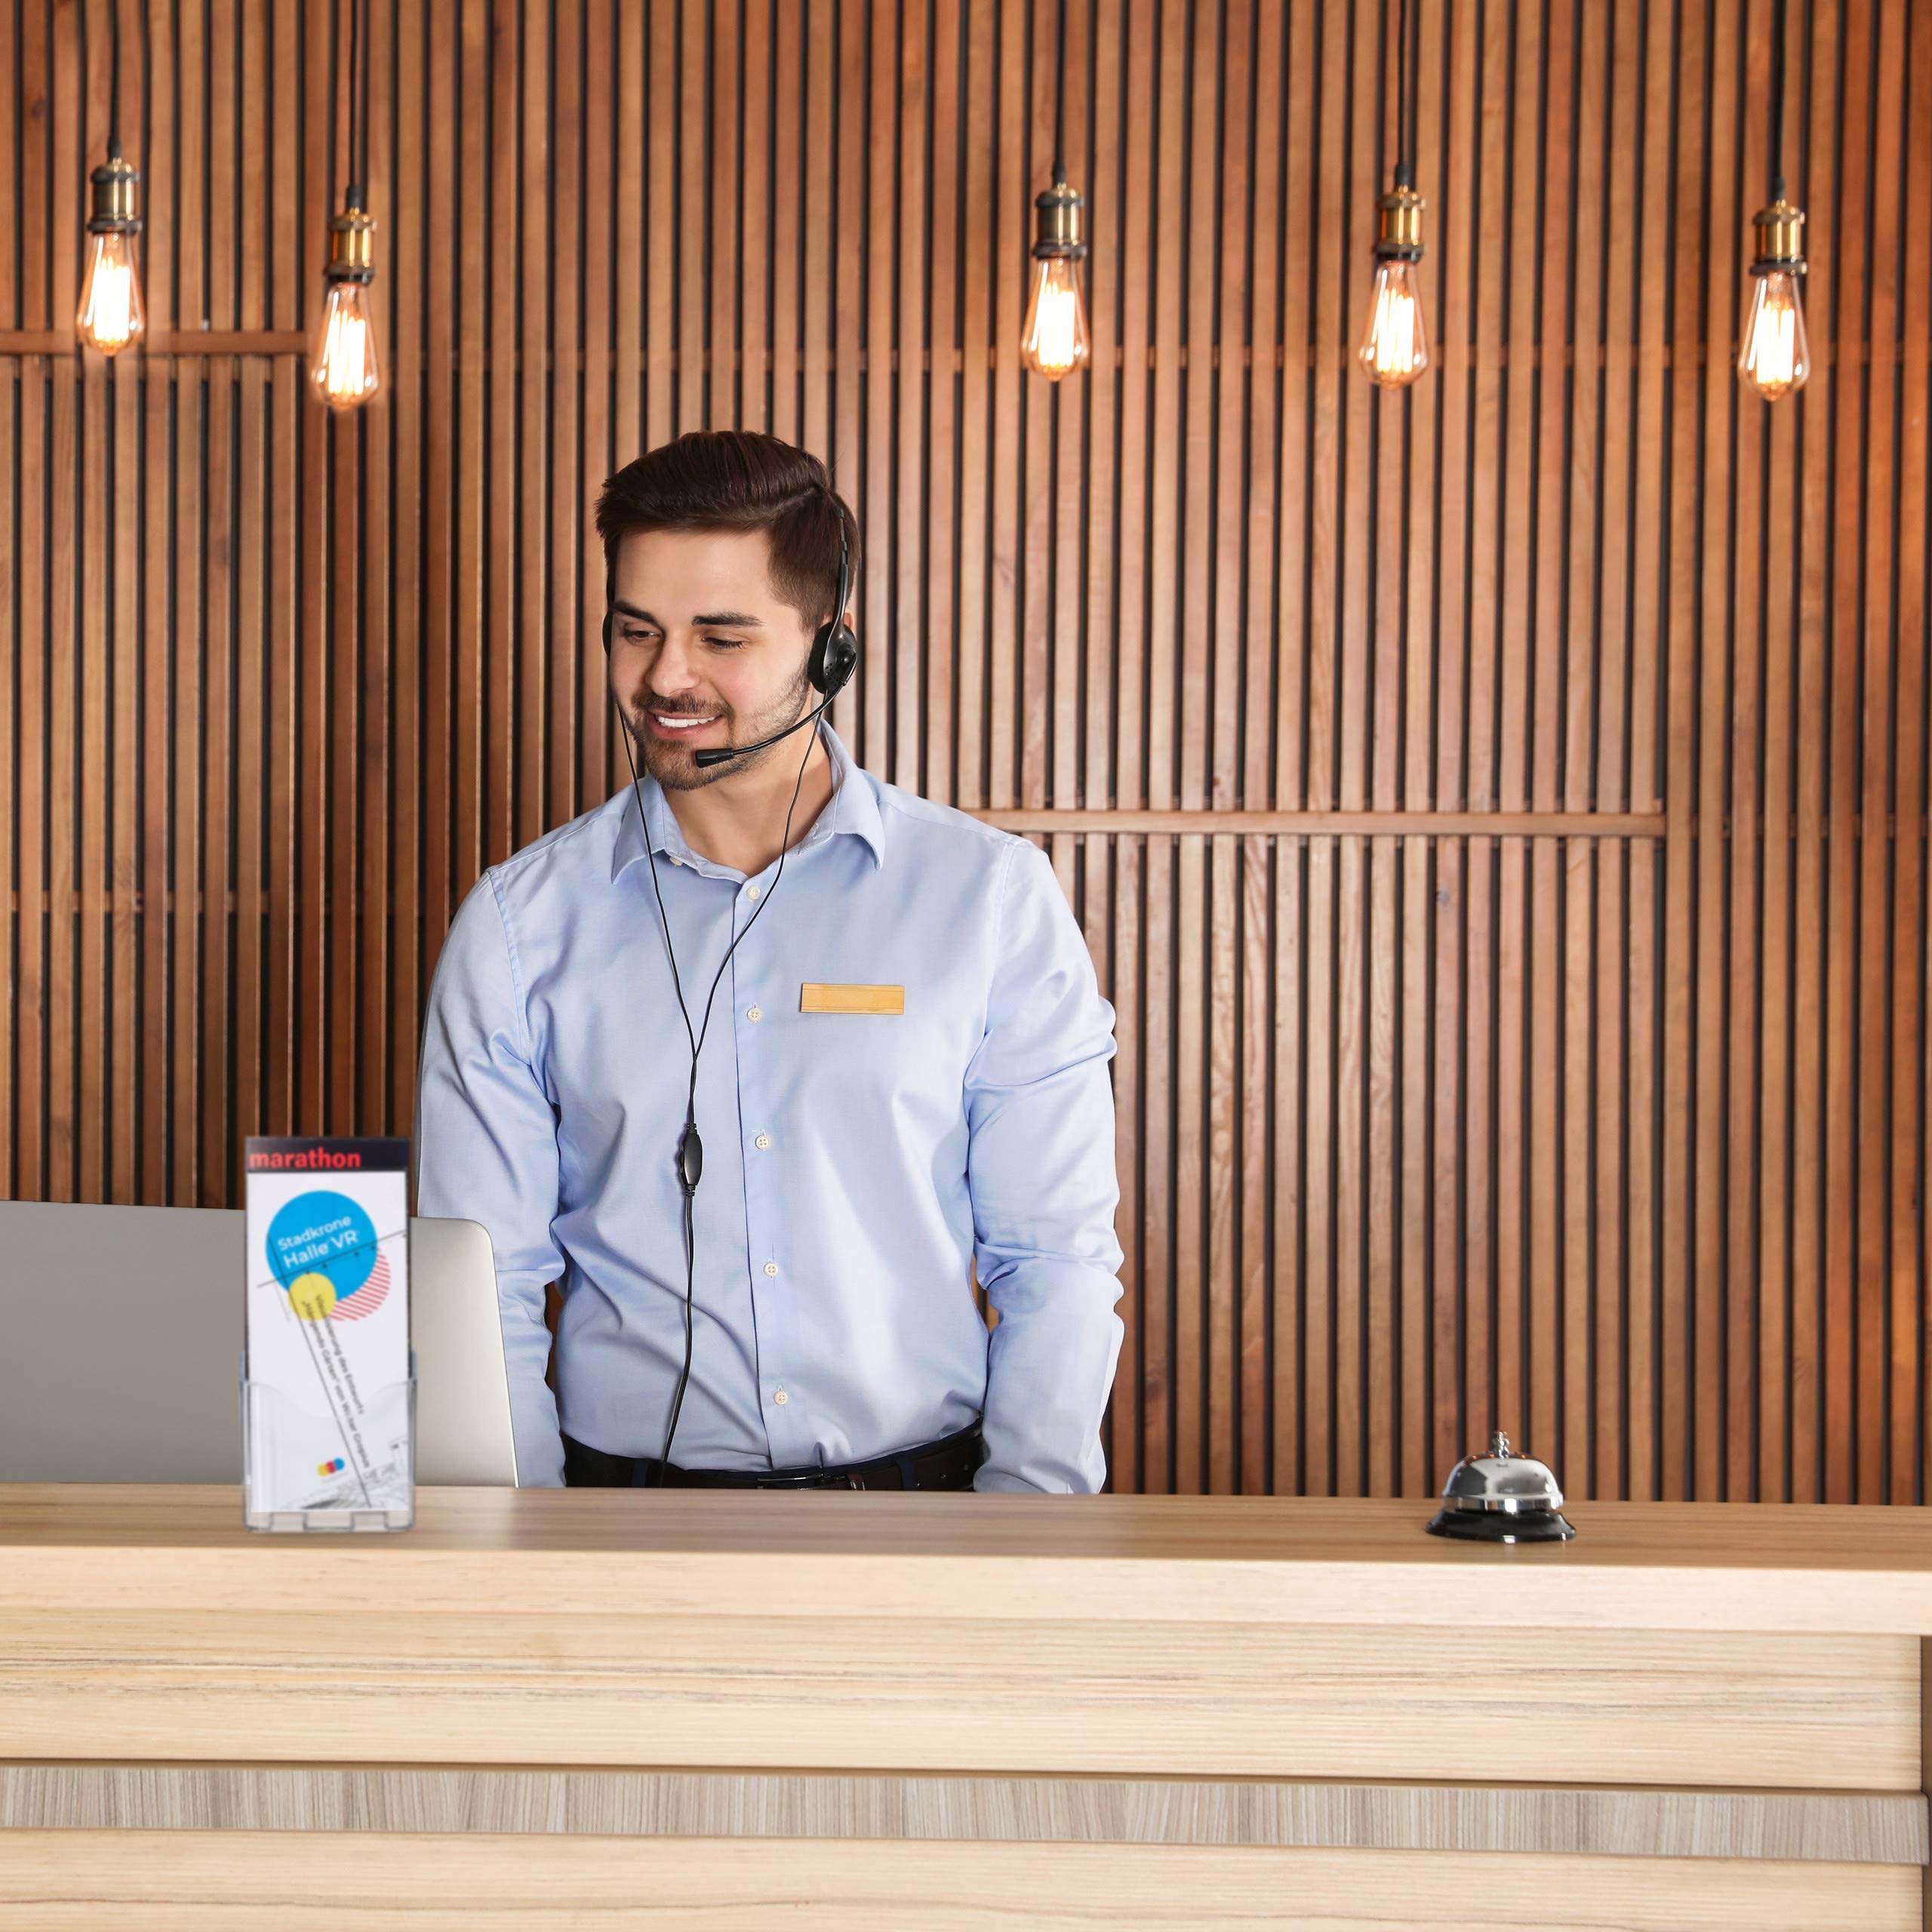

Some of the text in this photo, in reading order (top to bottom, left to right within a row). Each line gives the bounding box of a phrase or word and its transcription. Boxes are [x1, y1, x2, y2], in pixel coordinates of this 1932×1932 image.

[249, 1146, 361, 1168] marathon
[277, 1216, 352, 1251] Stadkrone
[283, 1229, 358, 1269] Halle VR
